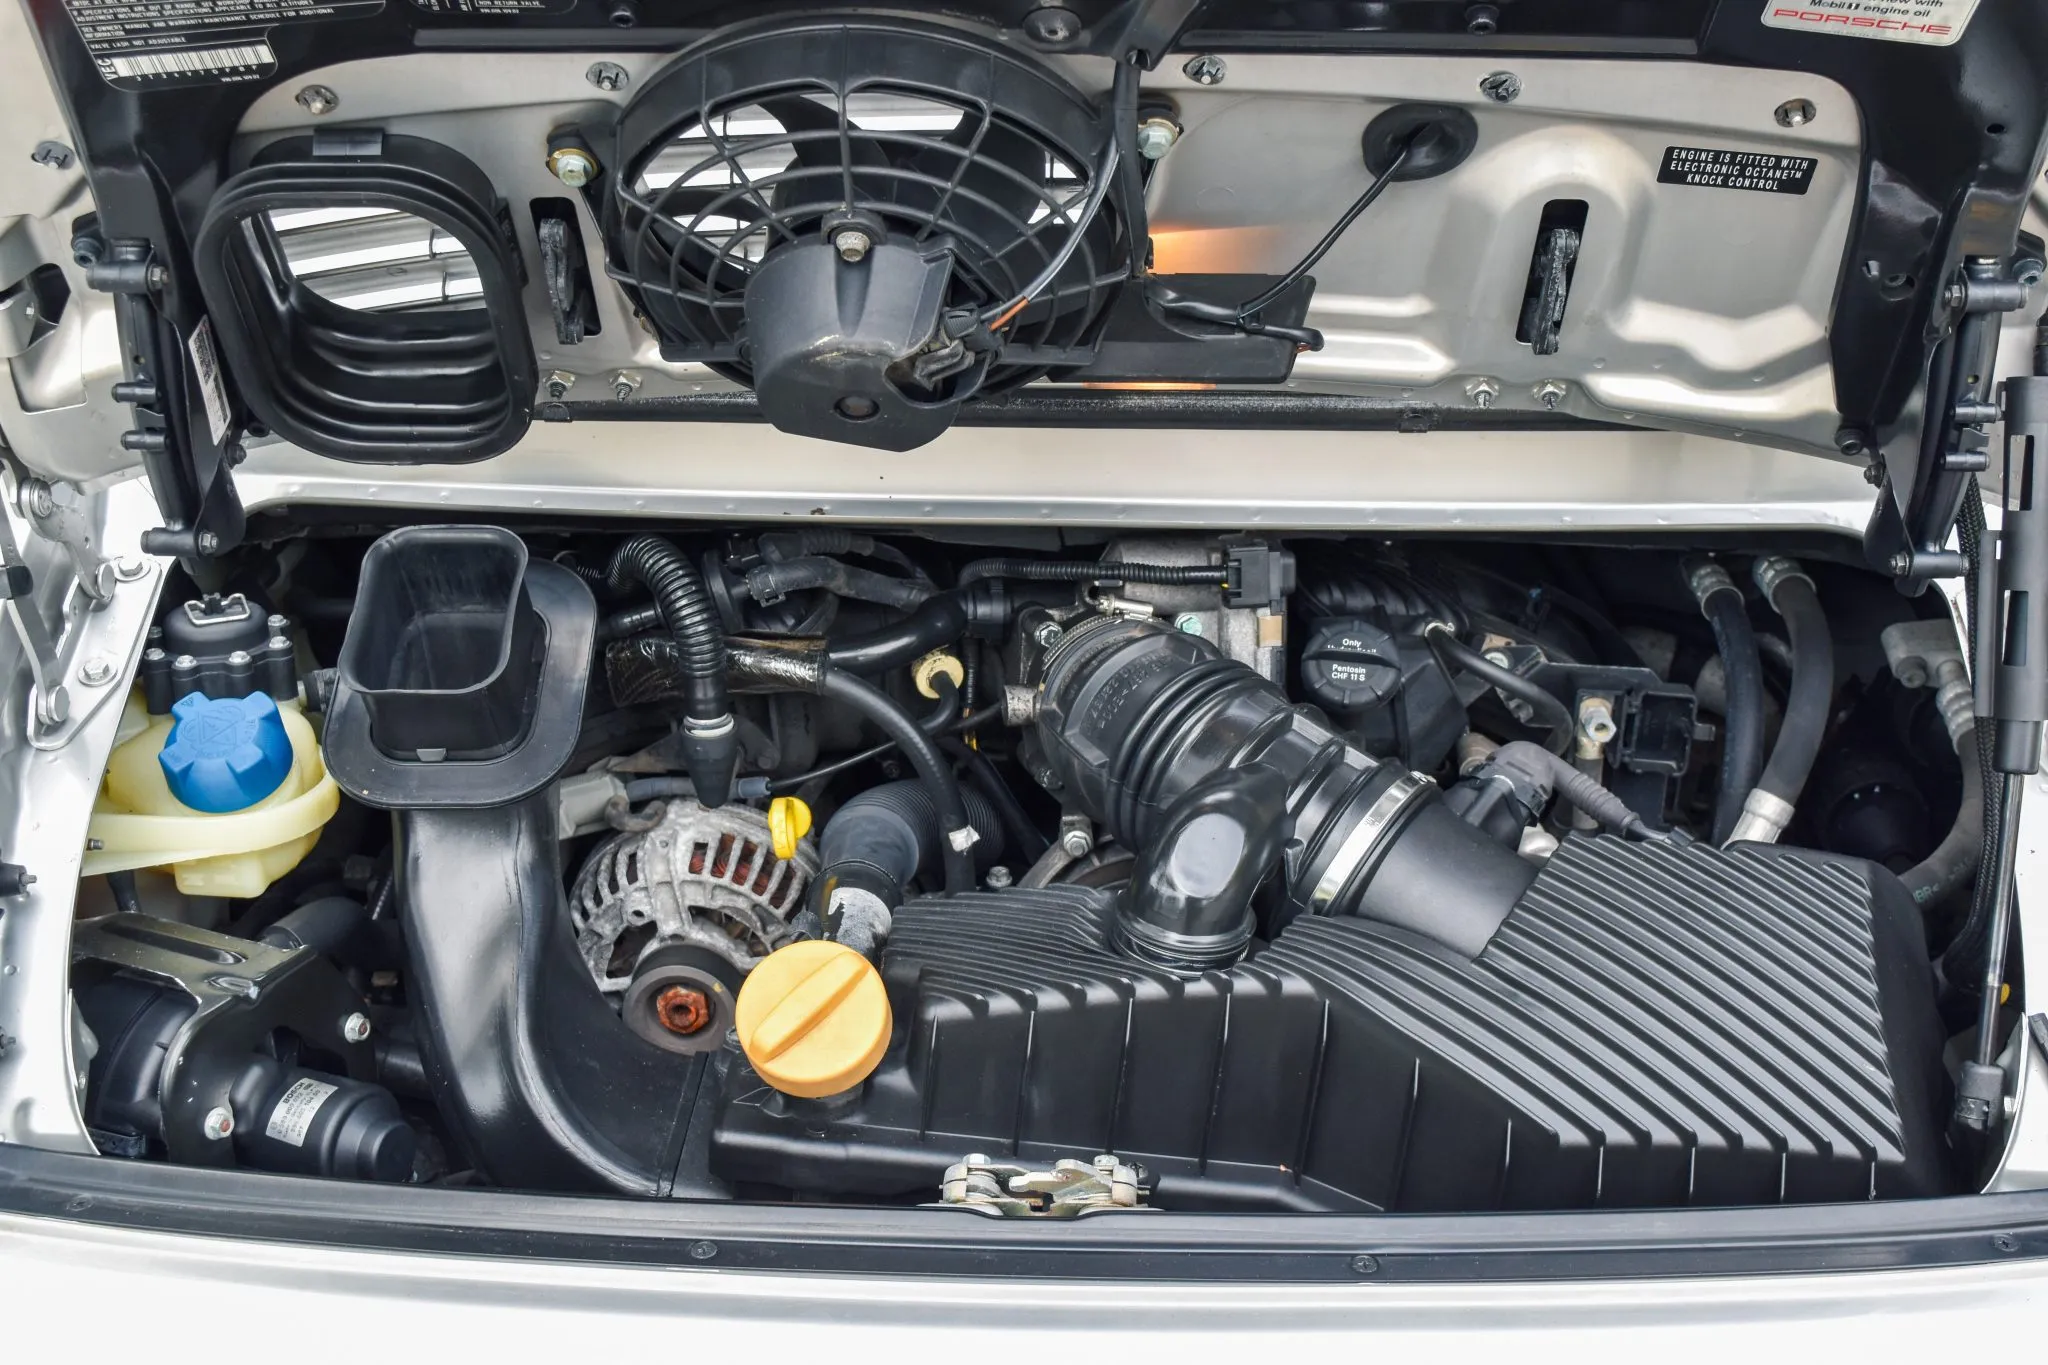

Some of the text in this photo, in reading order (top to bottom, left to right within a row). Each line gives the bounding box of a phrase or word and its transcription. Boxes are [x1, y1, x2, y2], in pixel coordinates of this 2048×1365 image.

[1810, 0, 1846, 9] Mobil
[1864, 5, 1909, 16] engine
[1914, 9, 1931, 17] oil
[1774, 10, 1952, 35] PORSCHE
[148, 36, 186, 45] ADJUSTABLE
[98, 58, 120, 80] VEC
[1672, 149, 1808, 170] ENGINE IS FITTED WITH
[1670, 161, 1740, 175] ELECTRONIC
[1686, 174, 1778, 190] KNOCK CONTROL
[1342, 638, 1362, 648] Only
[1332, 664, 1366, 674] Pentosin
[283, 1082, 305, 1104] BOSCH
